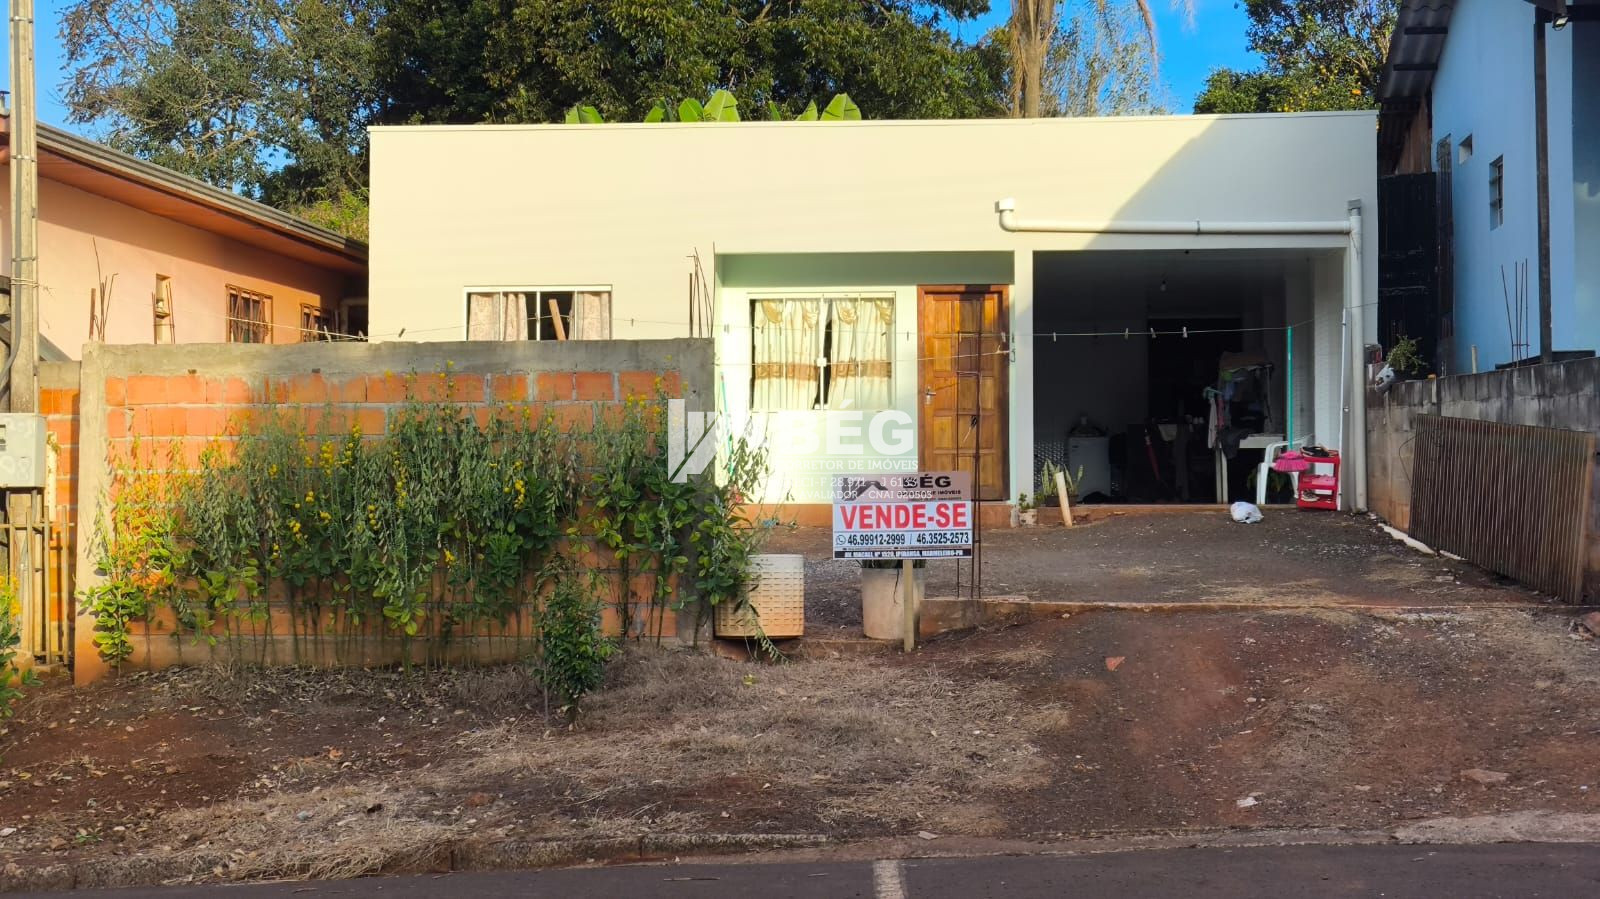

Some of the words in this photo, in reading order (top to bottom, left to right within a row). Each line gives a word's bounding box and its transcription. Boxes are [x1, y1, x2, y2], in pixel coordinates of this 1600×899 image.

[840, 503, 967, 529] VENDE-SE
[848, 533, 906, 545] 46.99912-2999
[917, 532, 969, 544] 46.3525-2573
